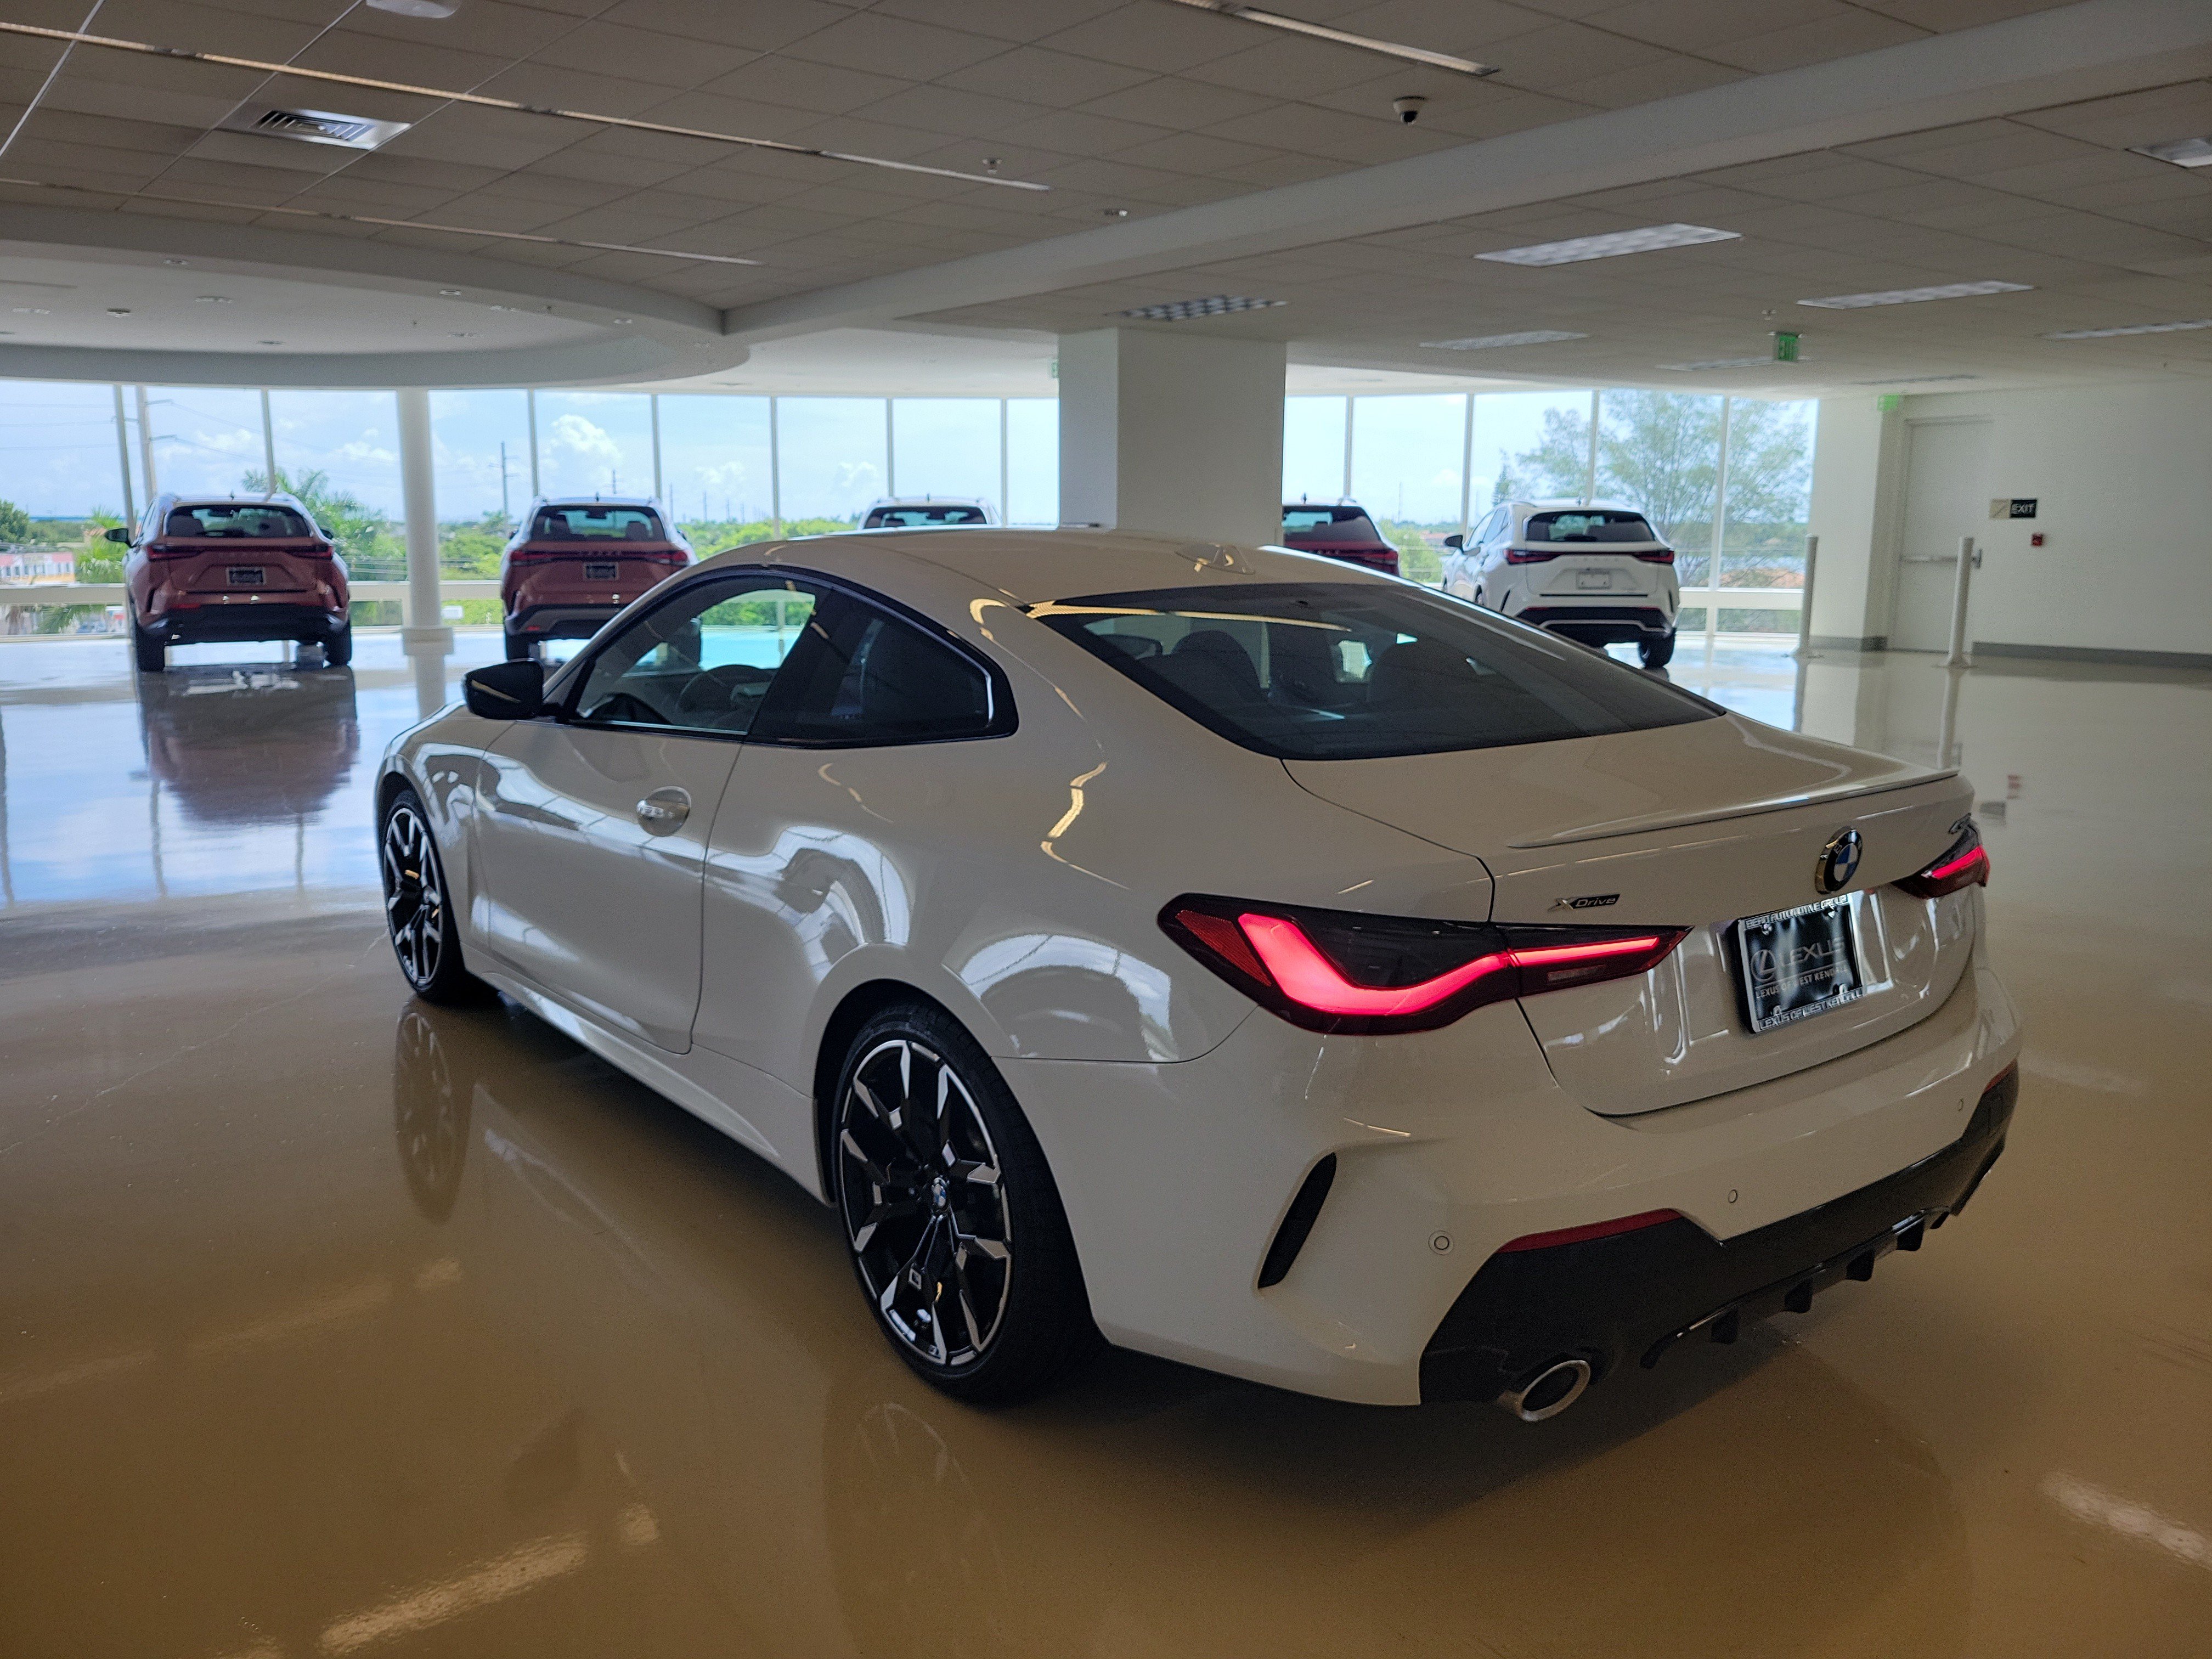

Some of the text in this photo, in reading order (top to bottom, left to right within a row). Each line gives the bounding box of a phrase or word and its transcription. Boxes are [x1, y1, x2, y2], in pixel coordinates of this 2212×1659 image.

[2011, 503, 2035, 514] EXIT
[1770, 902, 1821, 922] AUTOMOTIVE
[1760, 989, 1863, 1029] LEXUS OF WEST KENDALL
